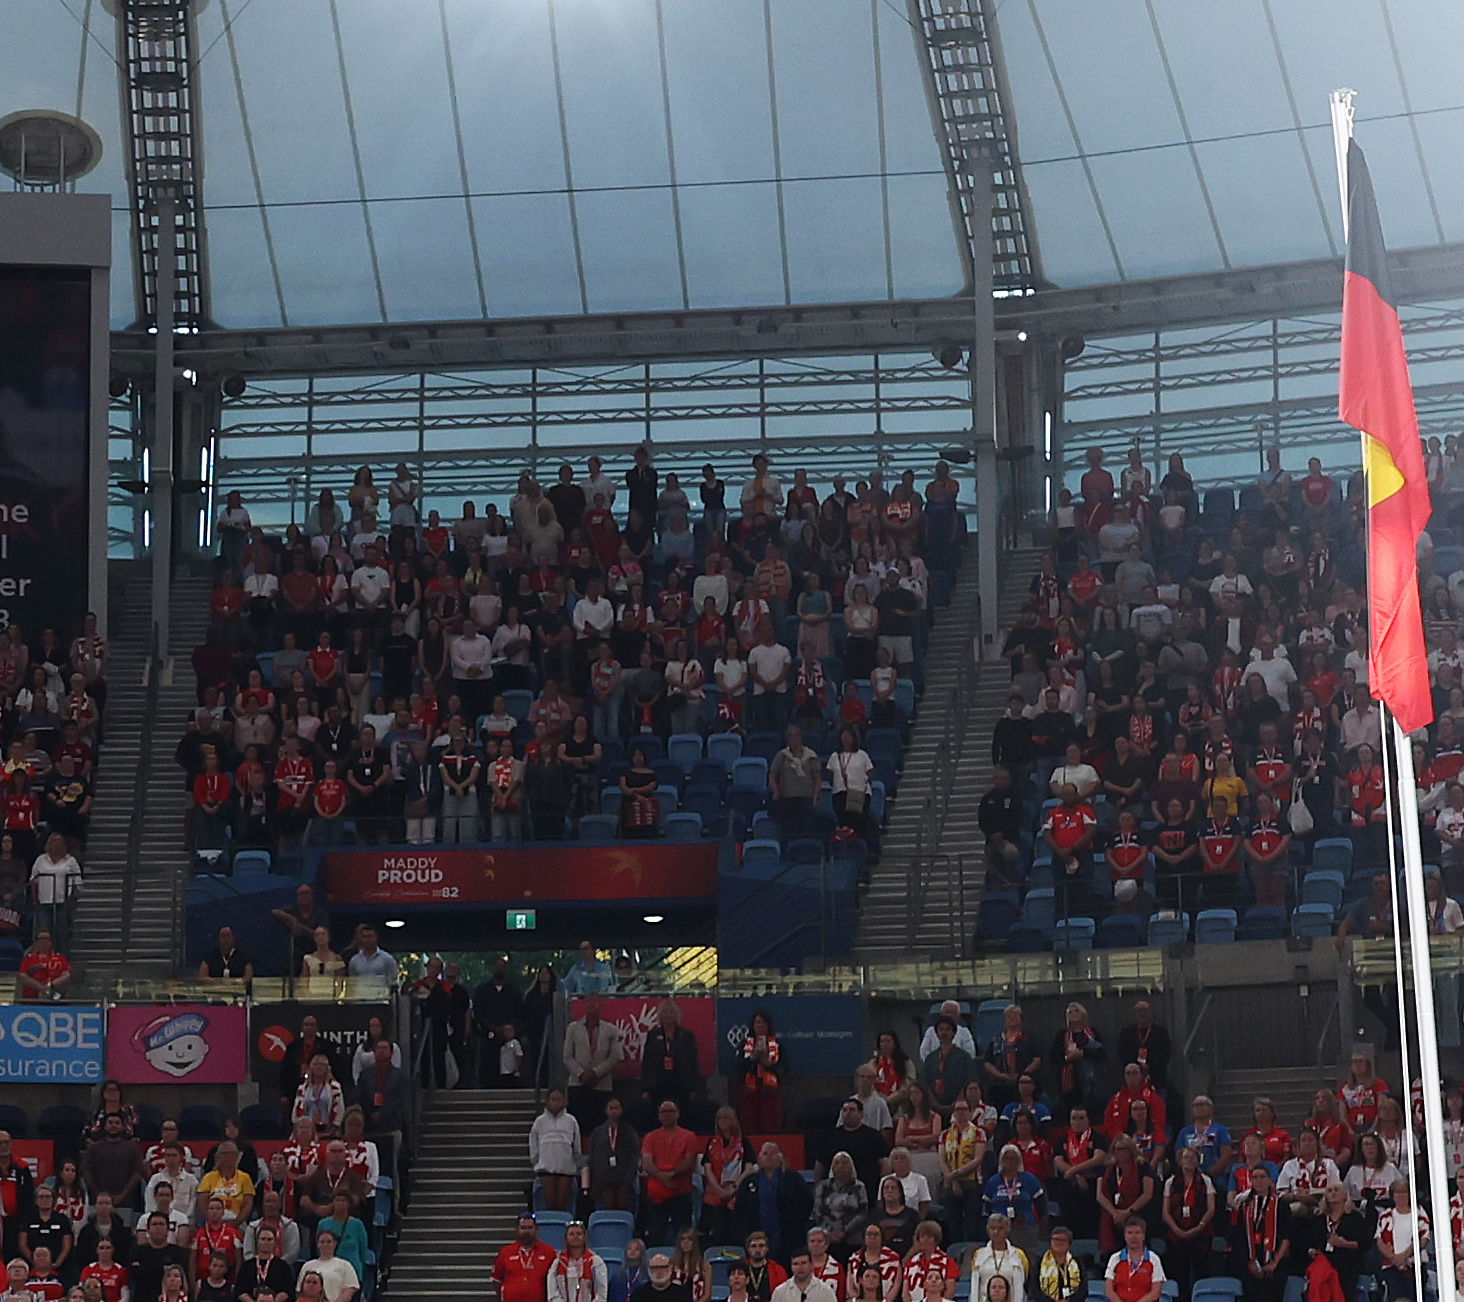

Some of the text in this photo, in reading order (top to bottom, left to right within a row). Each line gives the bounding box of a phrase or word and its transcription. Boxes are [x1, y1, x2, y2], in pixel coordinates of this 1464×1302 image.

[383, 856, 438, 870] MADDY
[377, 868, 444, 884] PROUD
[11, 1011, 101, 1049] QBE
